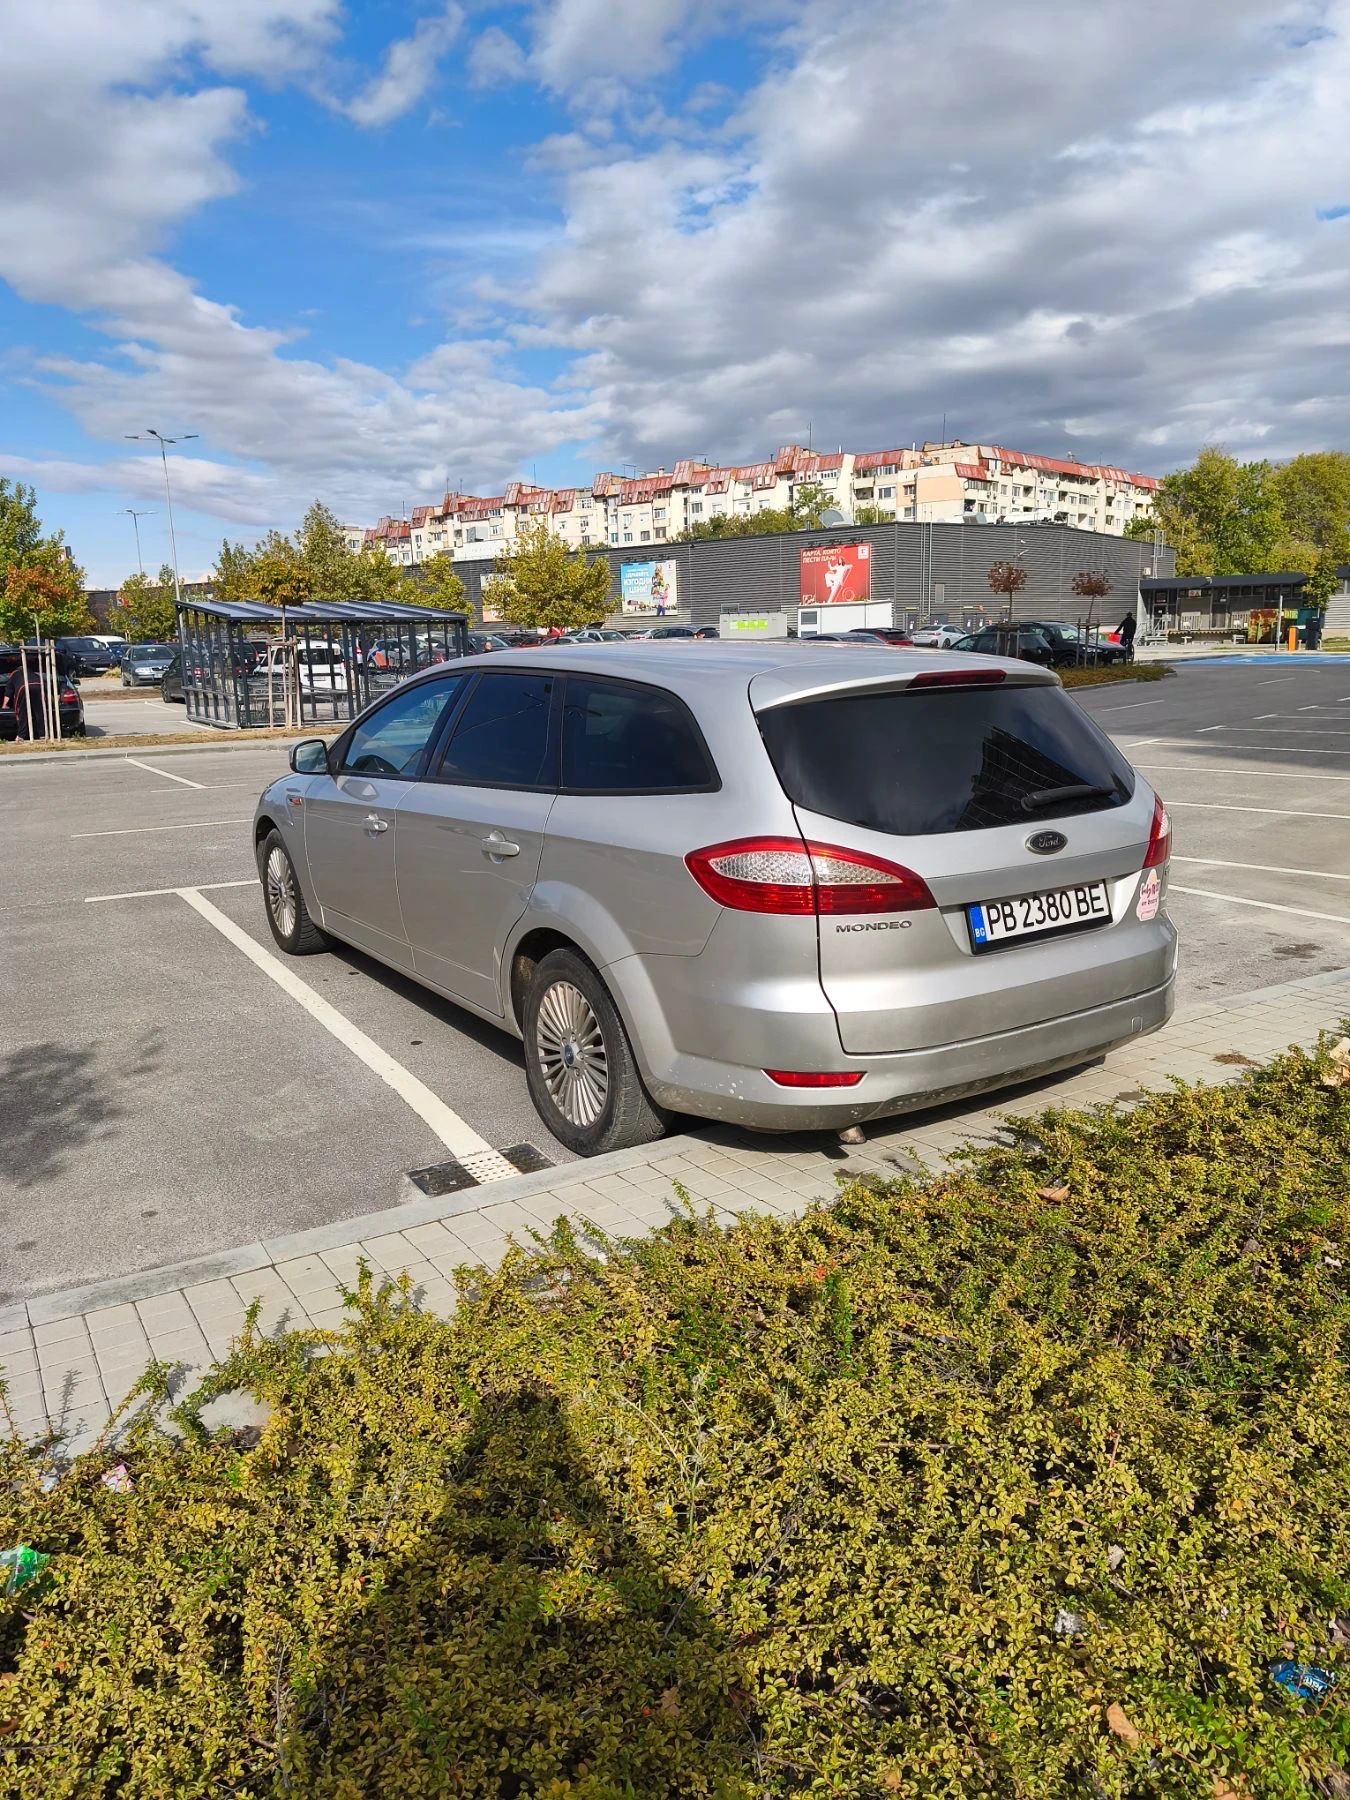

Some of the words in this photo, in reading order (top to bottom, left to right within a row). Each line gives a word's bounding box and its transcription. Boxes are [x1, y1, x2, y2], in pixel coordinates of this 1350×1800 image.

[1038, 836, 1061, 848] Ford
[986, 901, 1017, 935] PB
[1019, 890, 1072, 928] 2380
[1074, 884, 1104, 917] BE
[835, 920, 912, 933] MONDEO
[974, 928, 986, 938] BG
